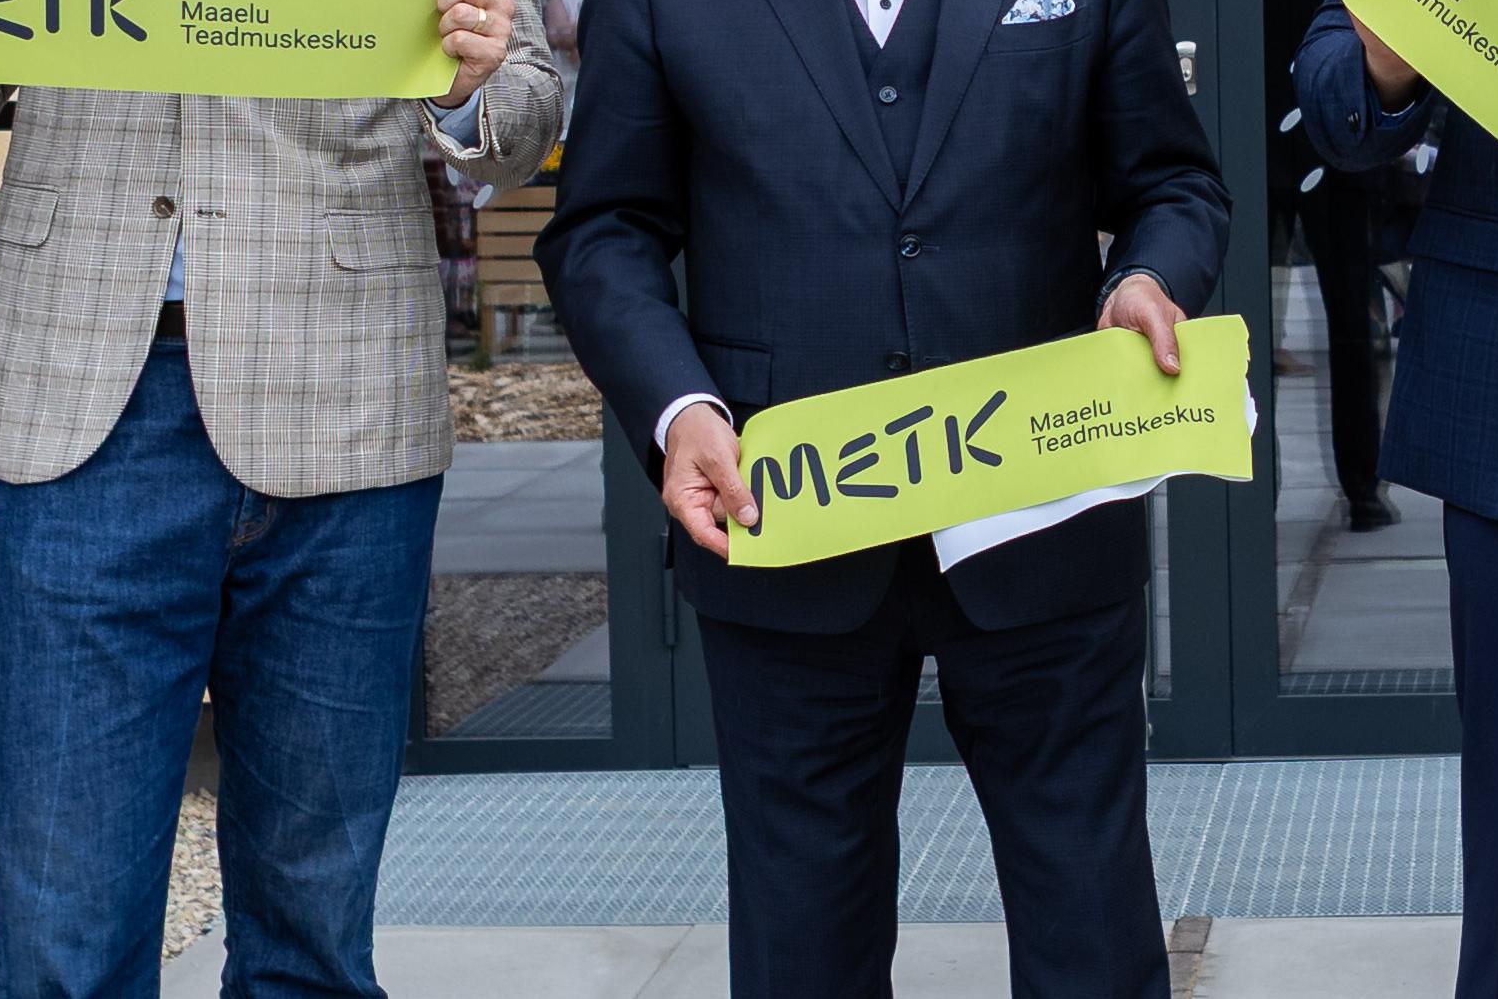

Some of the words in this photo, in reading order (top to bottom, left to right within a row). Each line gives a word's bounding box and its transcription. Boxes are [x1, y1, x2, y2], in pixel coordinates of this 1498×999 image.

[181, 0, 269, 25] Maaelu
[179, 24, 377, 50] Teadmuskeskus
[1030, 399, 1112, 434] Maaelu
[1031, 405, 1216, 455] Teadmuskeskus
[747, 390, 1008, 537] METK
